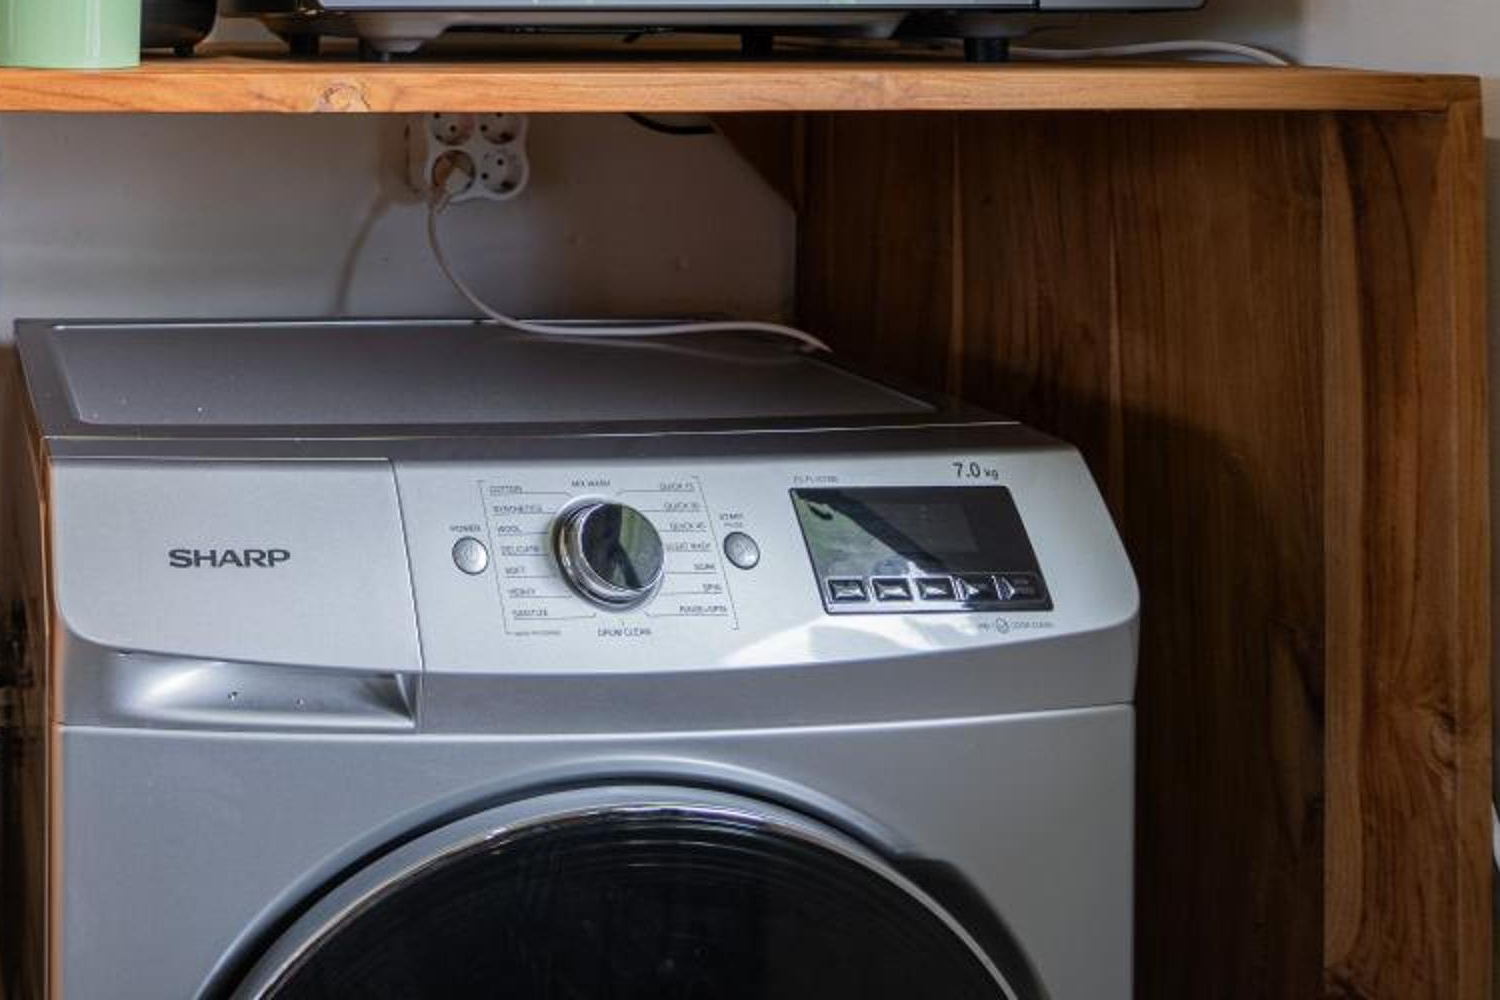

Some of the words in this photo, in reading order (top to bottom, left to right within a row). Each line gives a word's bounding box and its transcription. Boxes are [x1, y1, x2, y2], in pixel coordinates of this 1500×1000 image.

[952, 462, 980, 478] 7.0
[984, 468, 999, 480] kg
[169, 549, 291, 568] SHARP
